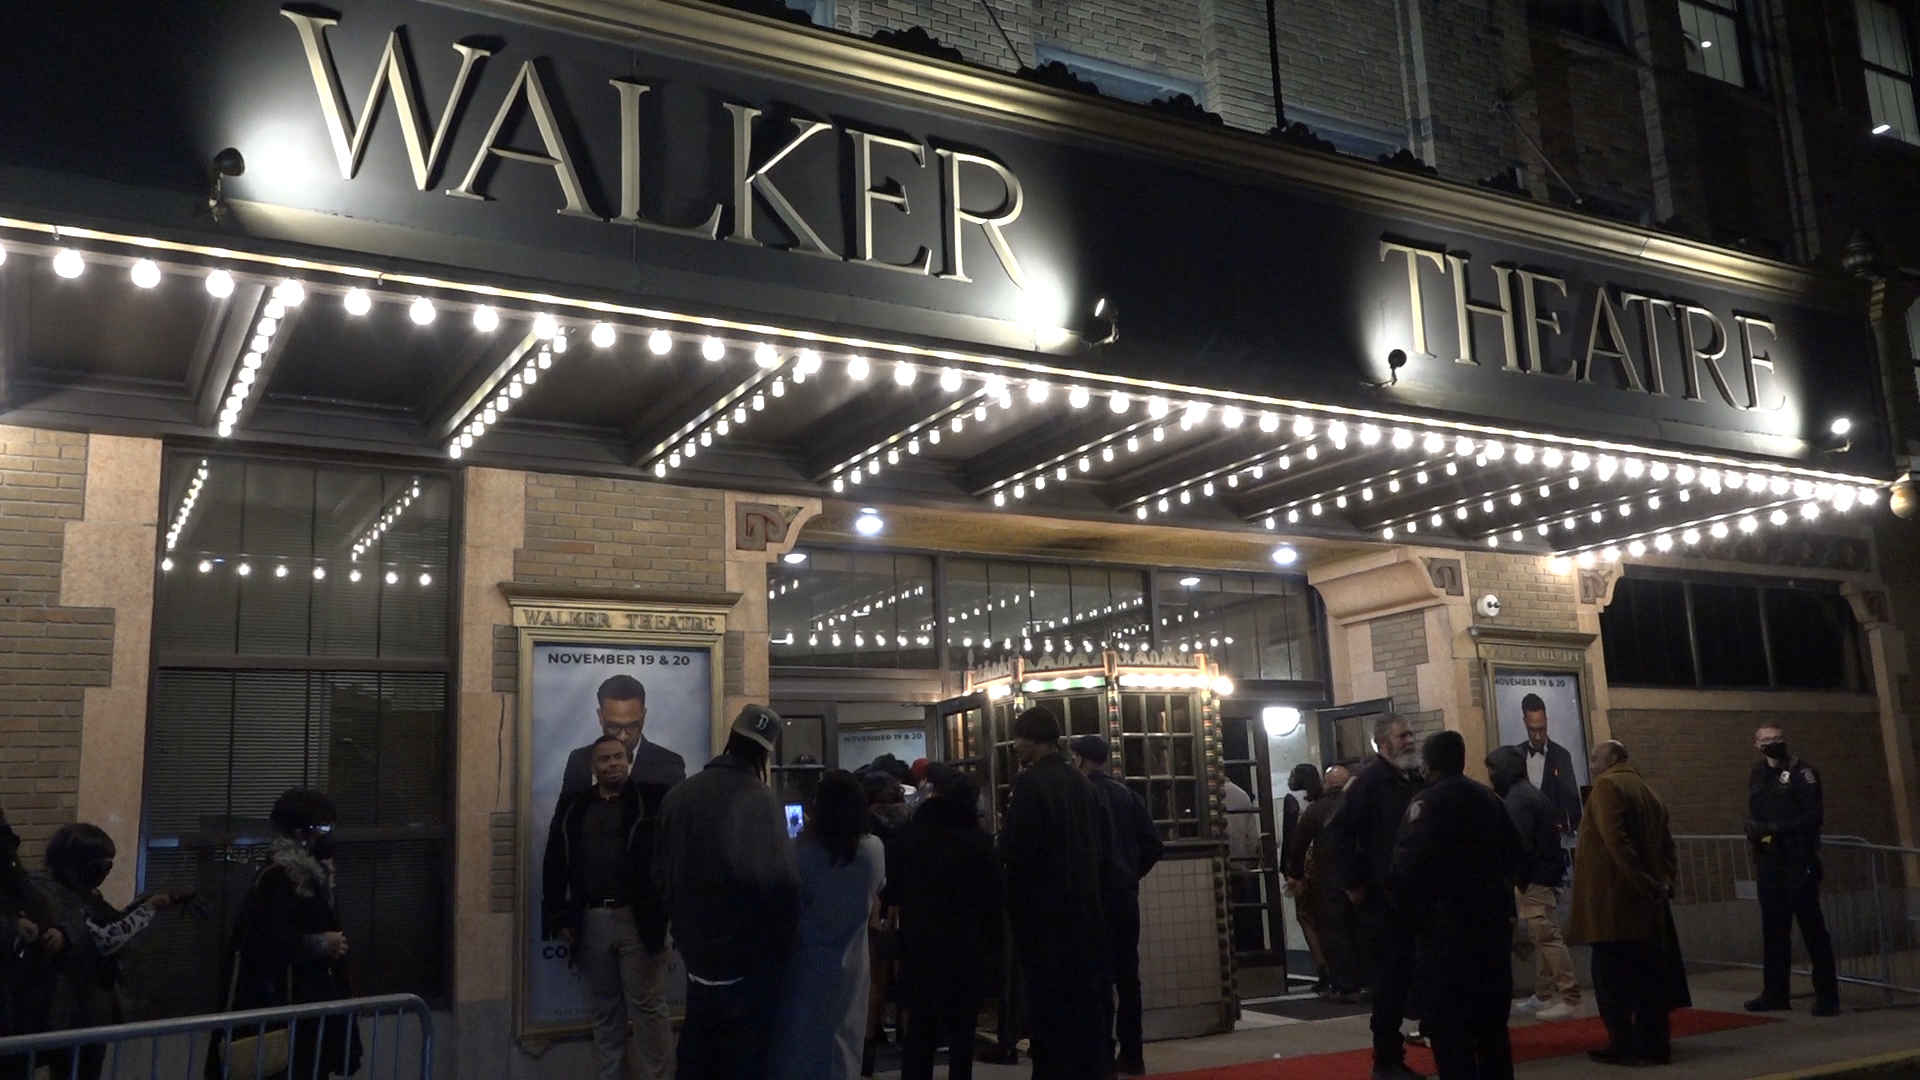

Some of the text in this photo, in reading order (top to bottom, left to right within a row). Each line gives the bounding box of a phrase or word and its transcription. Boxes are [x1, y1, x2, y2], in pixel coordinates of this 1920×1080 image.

[280, 4, 1787, 414] WALKER THEATRE
[523, 608, 717, 633] WALKER THEATRE
[547, 652, 690, 666] NOVEMBER 19 & 20
[1538, 679, 1547, 687] 19
[844, 733, 892, 742] NOVEMBER
[911, 732, 922, 740] 20
[542, 945, 568, 960] CO
